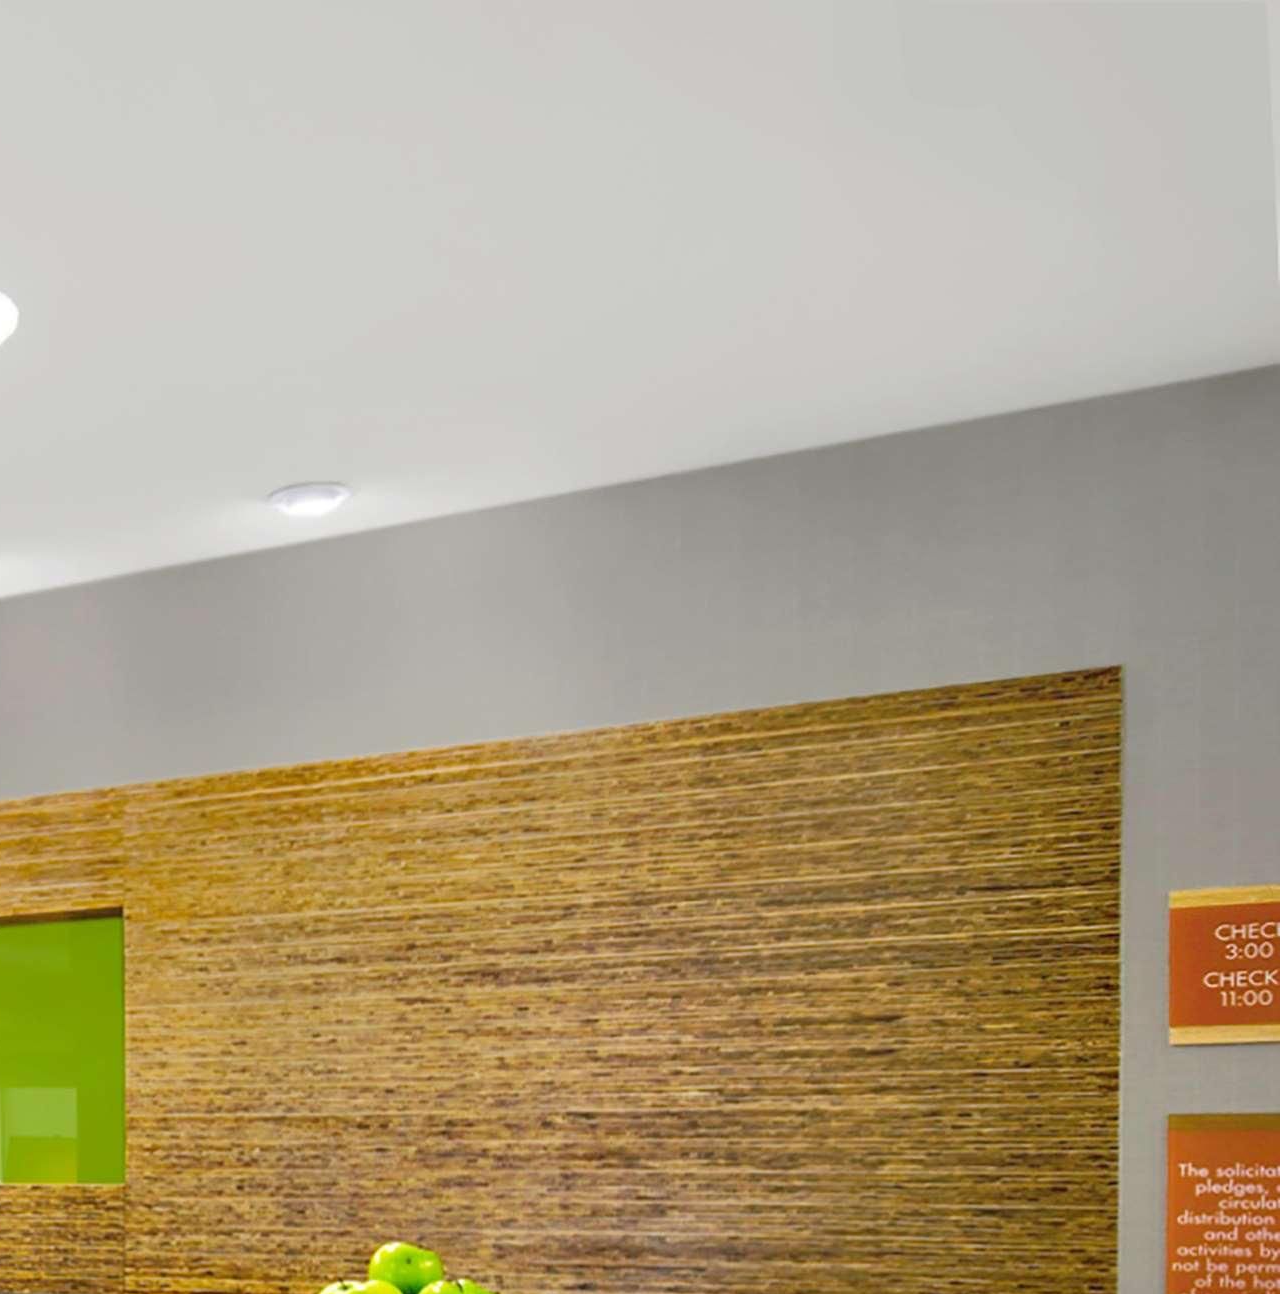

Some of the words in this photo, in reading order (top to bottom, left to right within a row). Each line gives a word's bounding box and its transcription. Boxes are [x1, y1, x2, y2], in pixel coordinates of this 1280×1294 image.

[1225, 941, 1274, 960] 3:00
[1203, 970, 1279, 988] CHECK
[1220, 989, 1273, 1007] 11:00
[1178, 1162, 1209, 1177] The
[1177, 1209, 1275, 1225] distribution
[1204, 1227, 1238, 1241] and
[1177, 1243, 1252, 1257] activities
[1260, 1243, 1280, 1261] by
[1172, 1260, 1199, 1272] not
[1206, 1258, 1228, 1272] be
[1194, 1273, 1212, 1287] of
[1219, 1274, 1245, 1289] the
